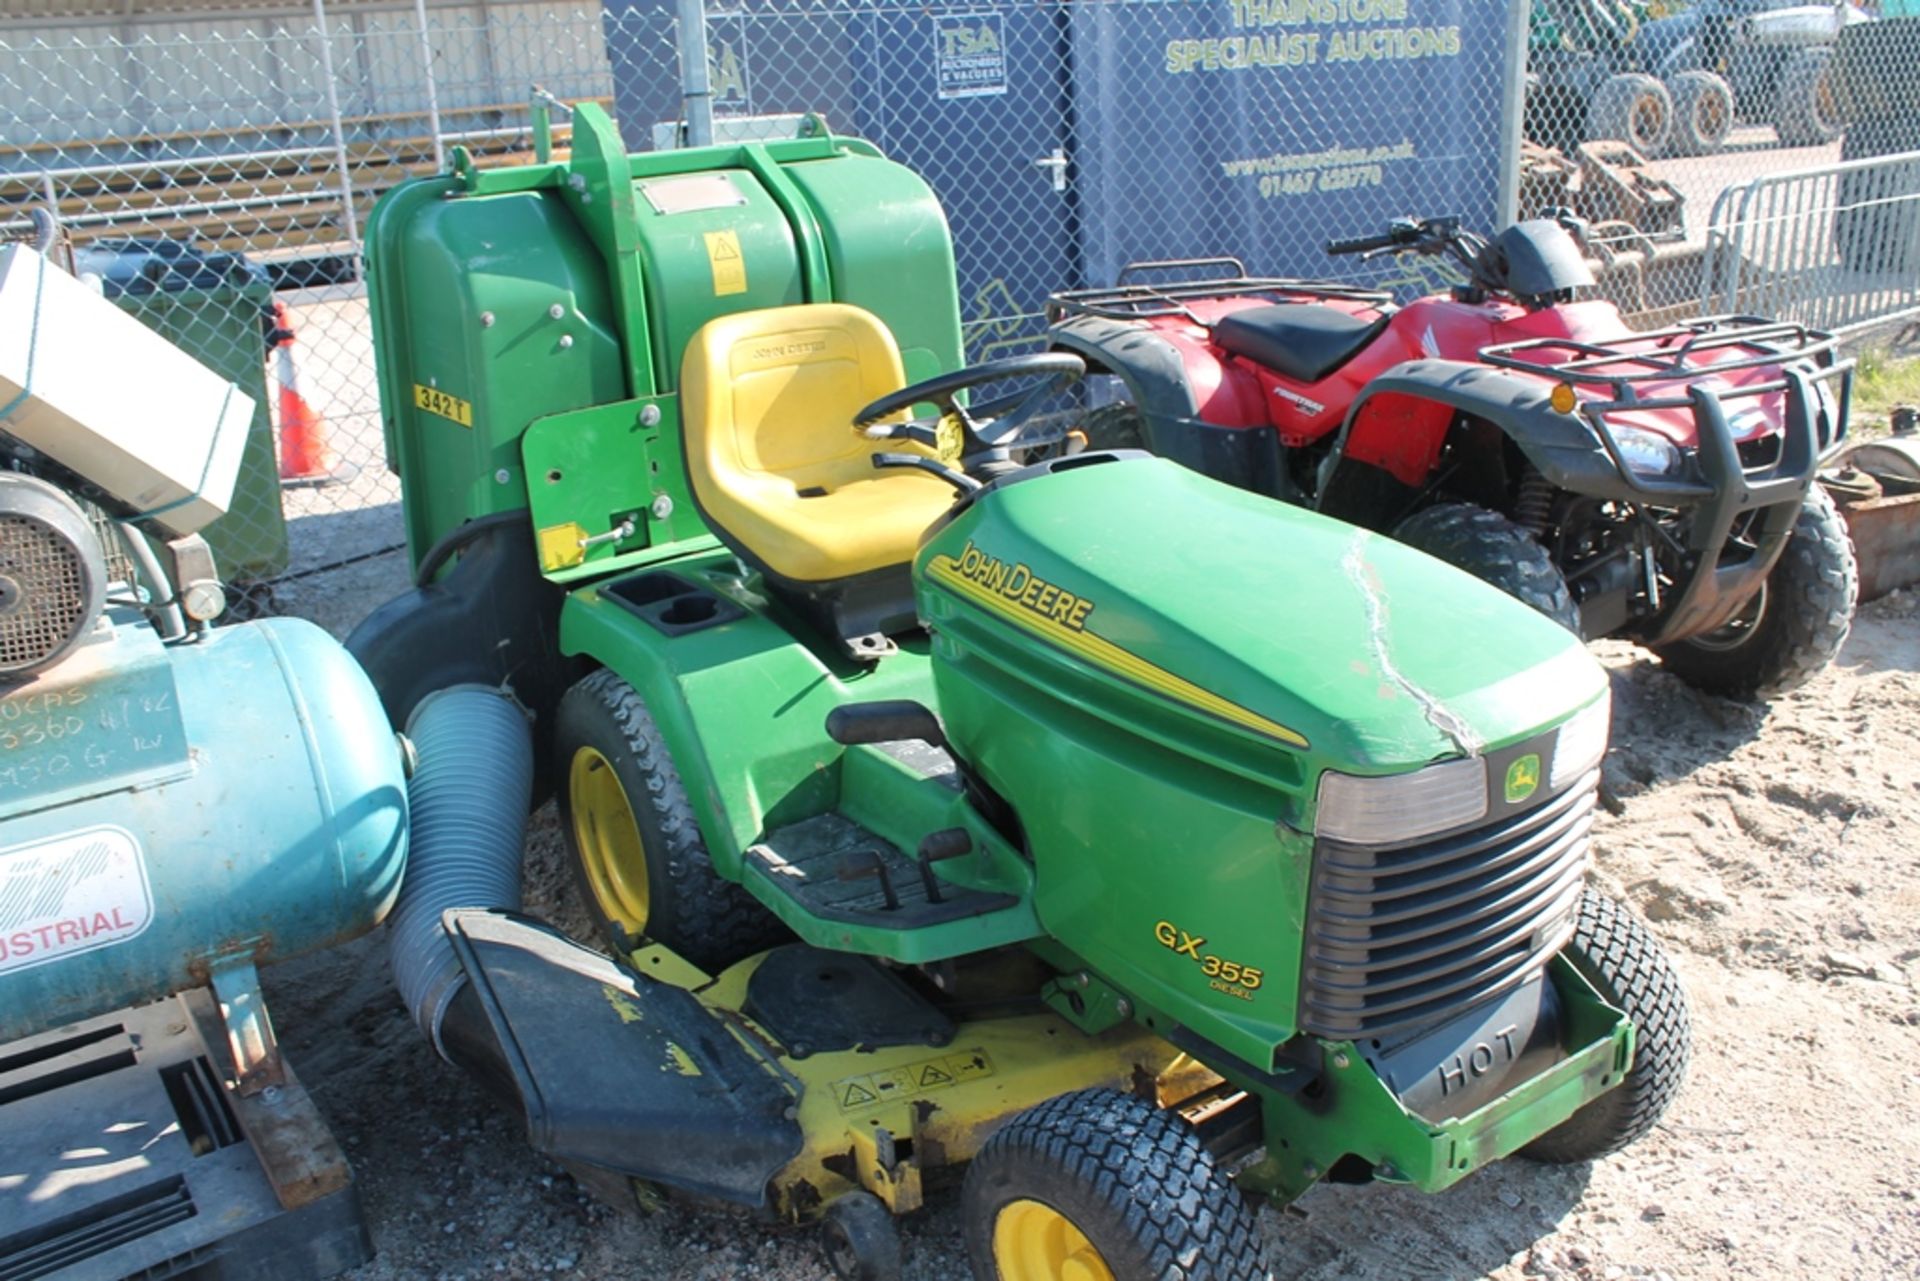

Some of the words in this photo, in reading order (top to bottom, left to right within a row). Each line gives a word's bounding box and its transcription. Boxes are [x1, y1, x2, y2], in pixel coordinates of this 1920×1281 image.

[1232, 0, 1407, 27] THAINSTONE
[940, 25, 1000, 55] TSA
[1166, 33, 1320, 73] SPECIALIST
[1326, 26, 1461, 62] AUCTIONS
[1259, 171, 1315, 198] 01467
[1210, 980, 1254, 1001] DIESEL
[1439, 1024, 1517, 1096] HOT
